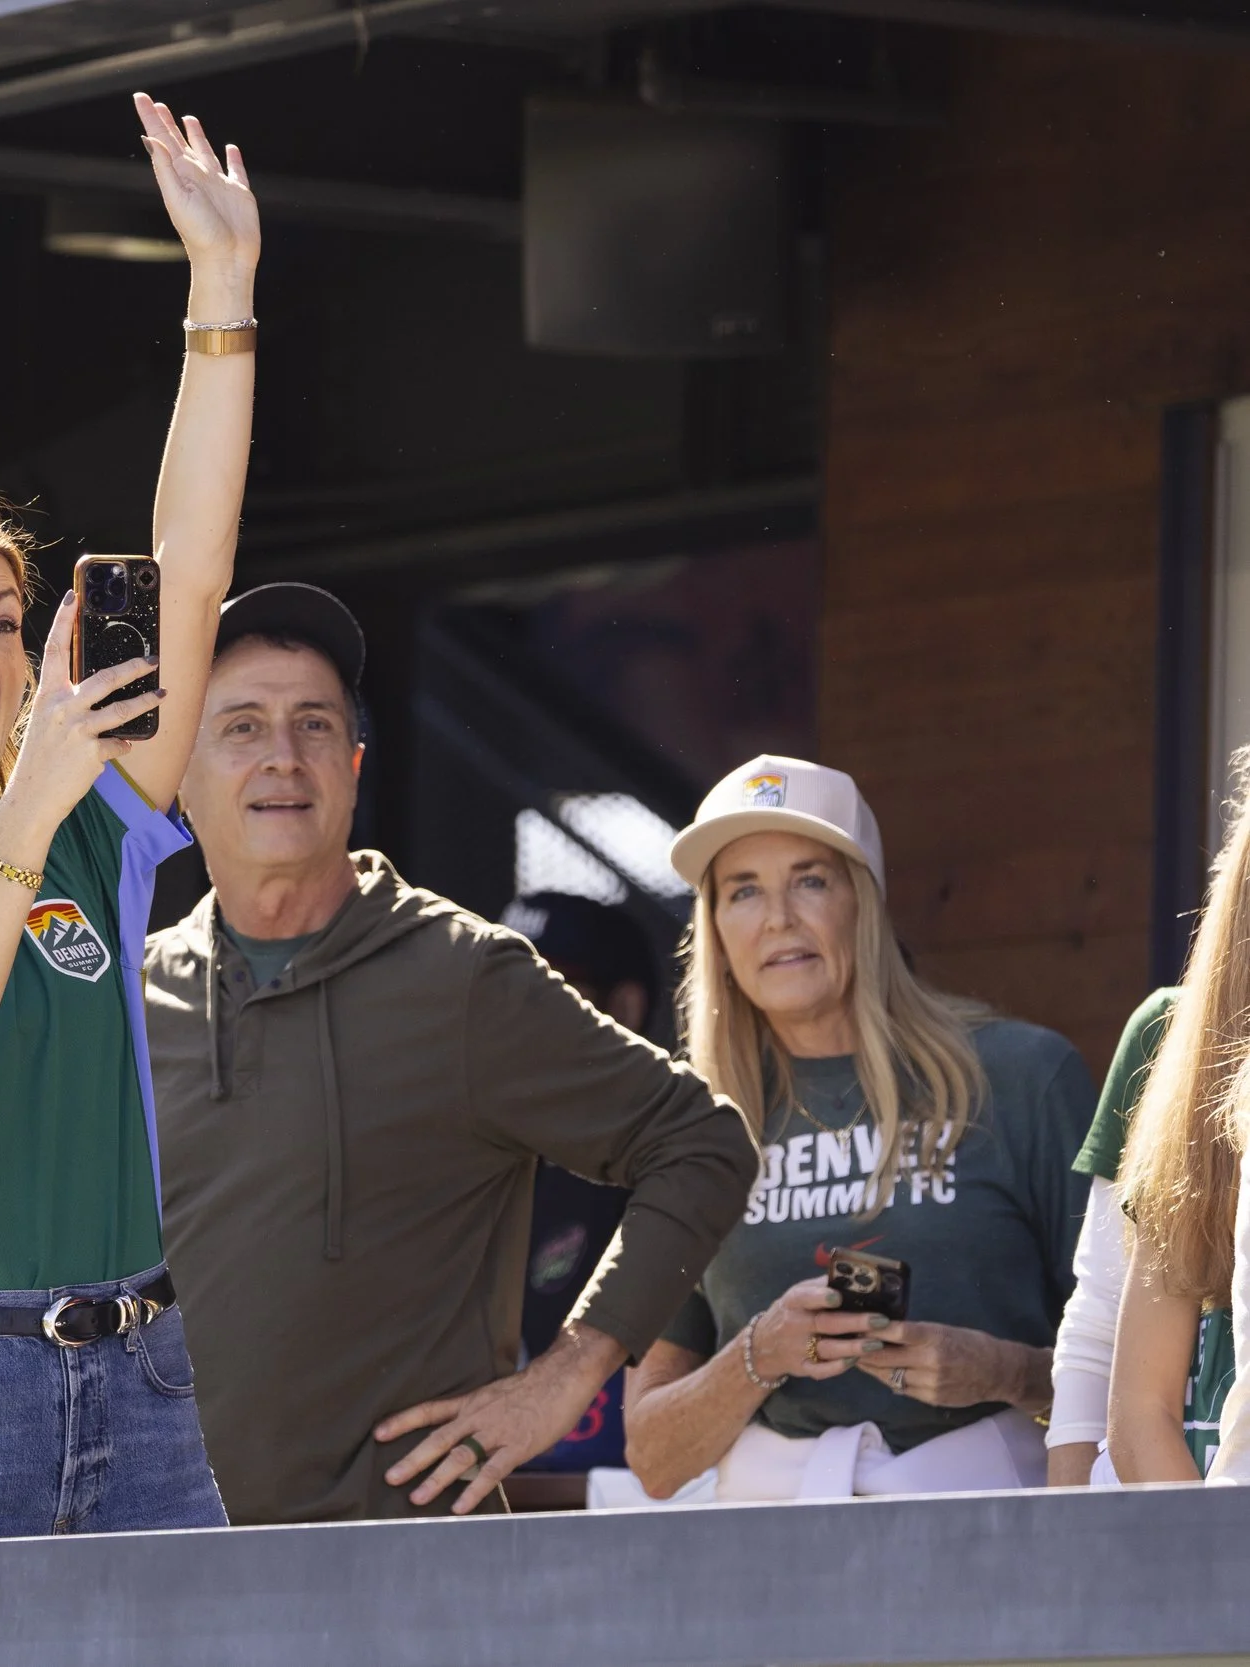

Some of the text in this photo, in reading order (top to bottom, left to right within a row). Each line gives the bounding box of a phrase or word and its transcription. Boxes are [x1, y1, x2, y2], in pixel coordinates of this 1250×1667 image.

[52, 941, 101, 963] DENVER
[67, 957, 99, 969] SUMMIT
[910, 1169, 956, 1205] FC
